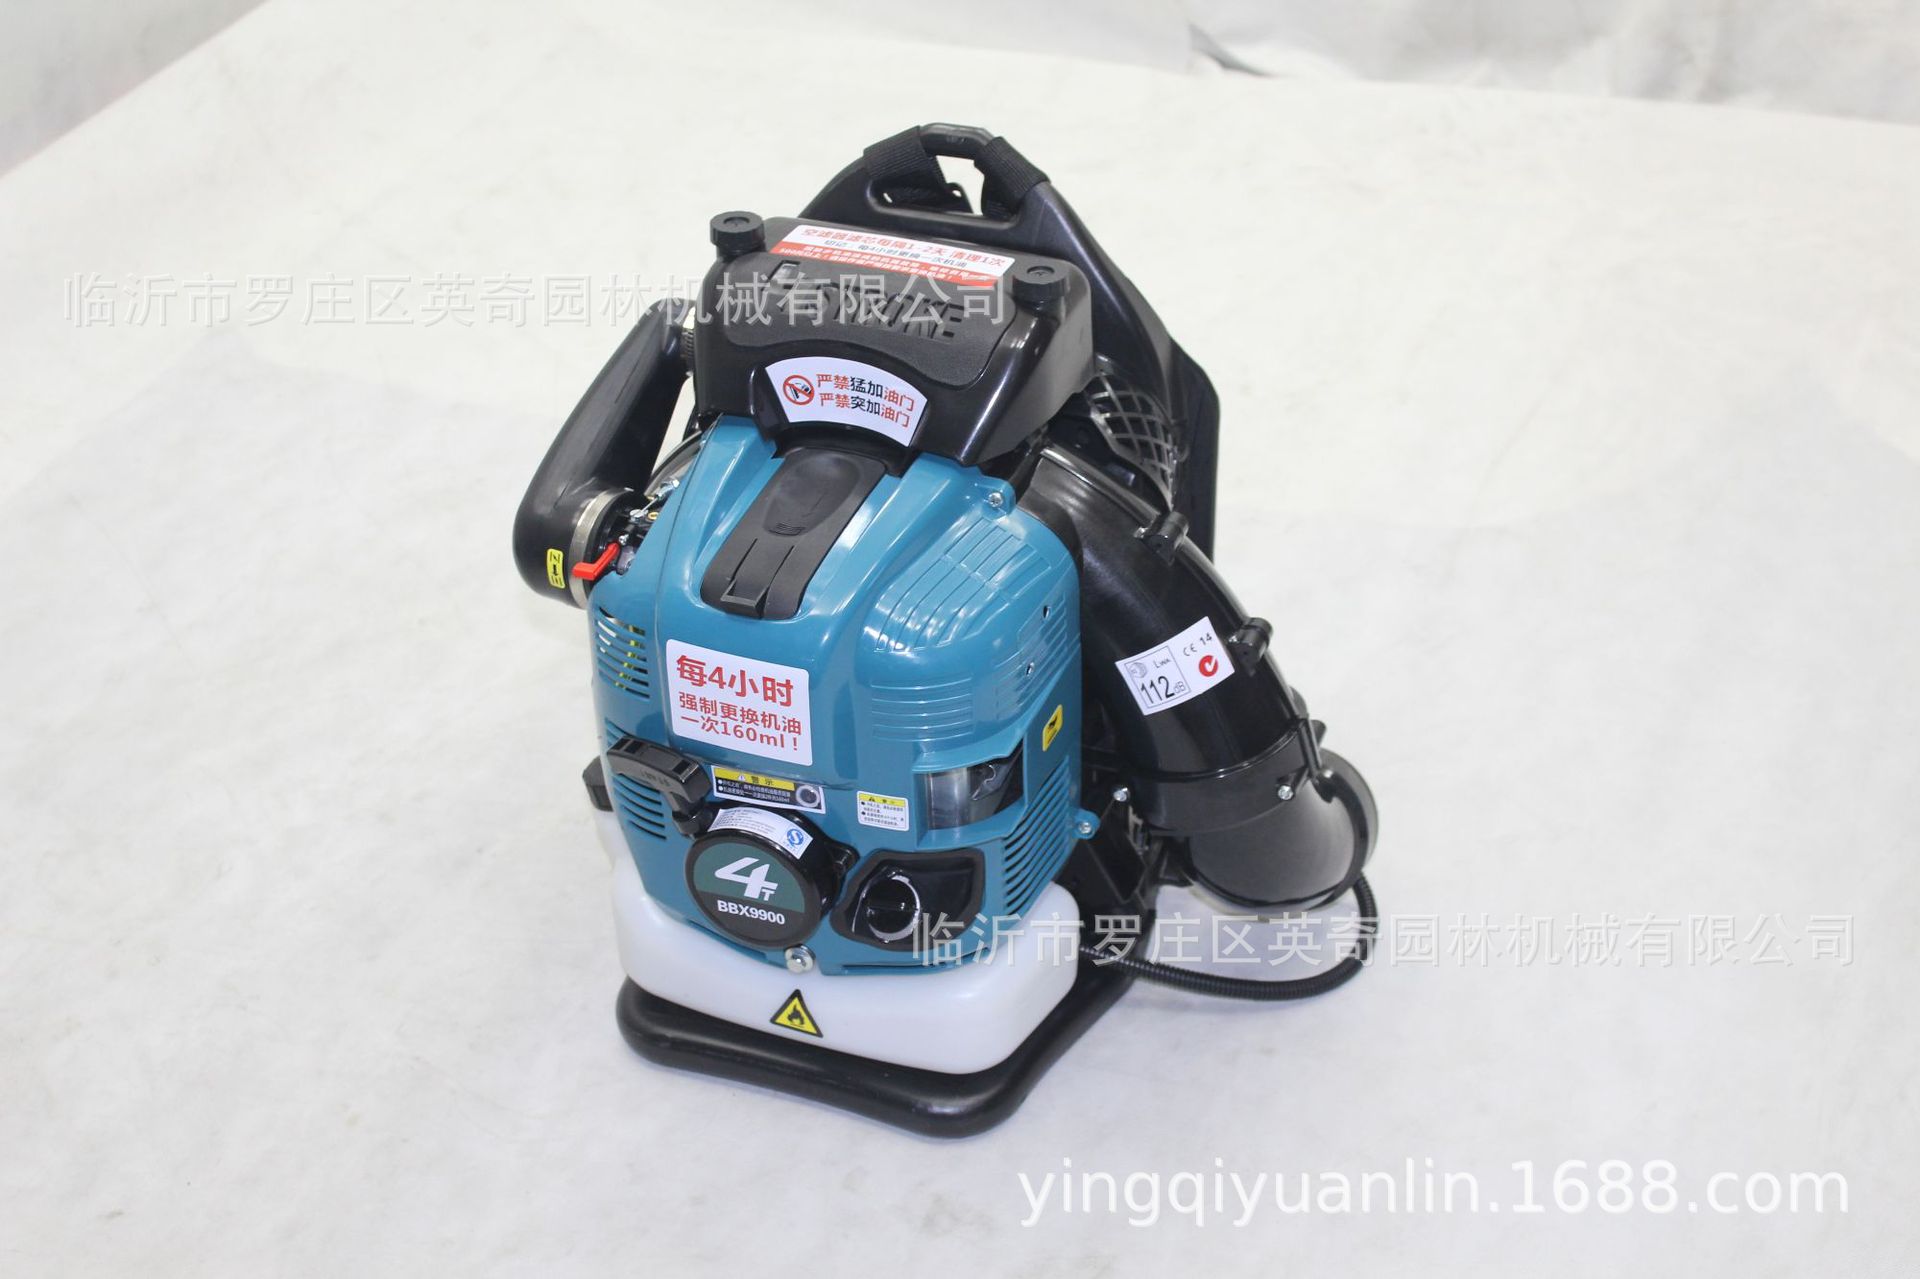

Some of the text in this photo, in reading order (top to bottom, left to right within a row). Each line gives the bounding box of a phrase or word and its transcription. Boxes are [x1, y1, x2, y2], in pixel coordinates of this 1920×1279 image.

[816, 373, 915, 412] 严禁猛加油门
[819, 392, 911, 428] 严禁突加油门
[676, 655, 794, 707] 每4小时
[1141, 675, 1175, 704] 112
[679, 692, 802, 736] 强制更换机油
[717, 899, 786, 925] BBX9900
